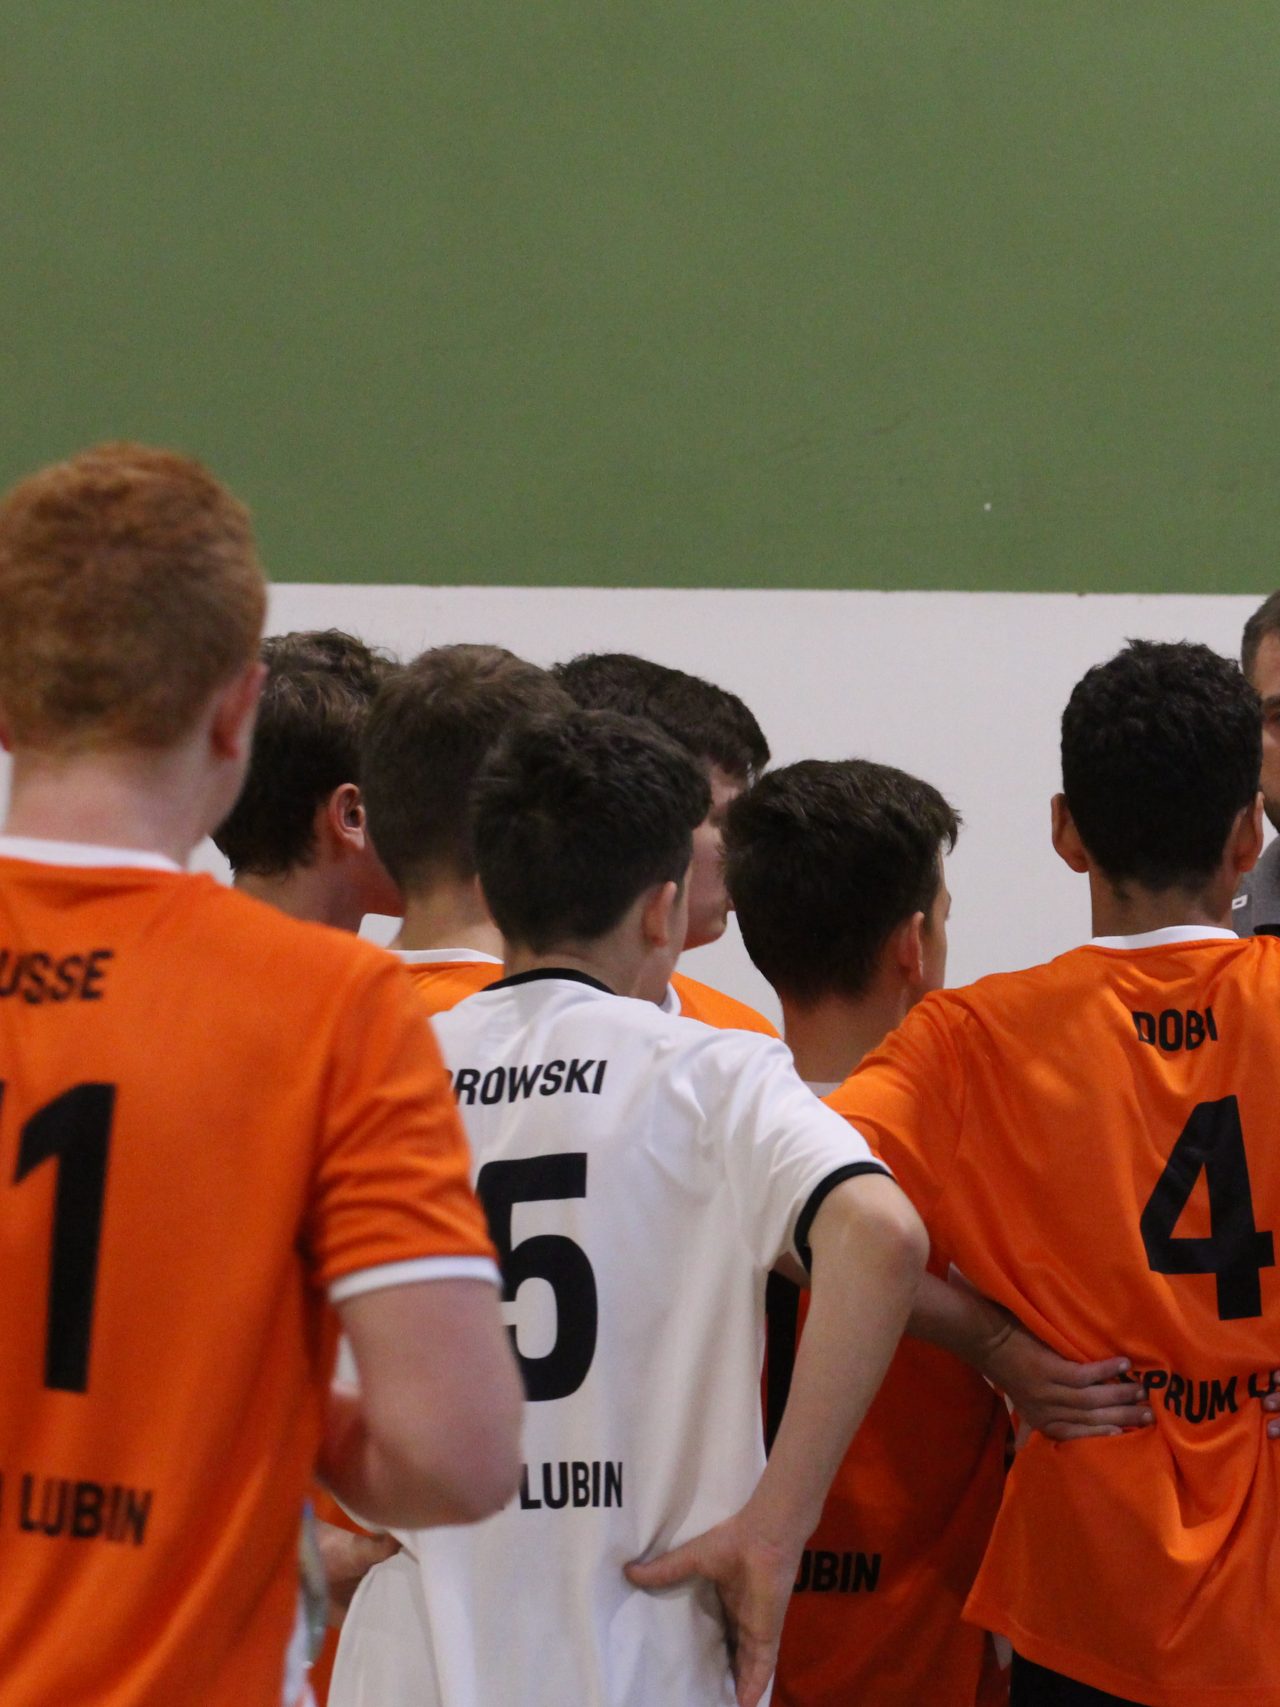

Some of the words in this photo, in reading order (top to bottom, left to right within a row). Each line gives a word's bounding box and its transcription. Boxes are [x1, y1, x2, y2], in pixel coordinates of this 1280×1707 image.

[1132, 1007, 1218, 1052] DOBI
[445, 1058, 608, 1105] ROWSKI
[0, 1079, 117, 1393] 1
[1140, 1094, 1275, 1321] 4
[475, 1152, 598, 1402] 5
[20, 1473, 153, 1547] LUBIN
[519, 1461, 623, 1509] LUBIN
